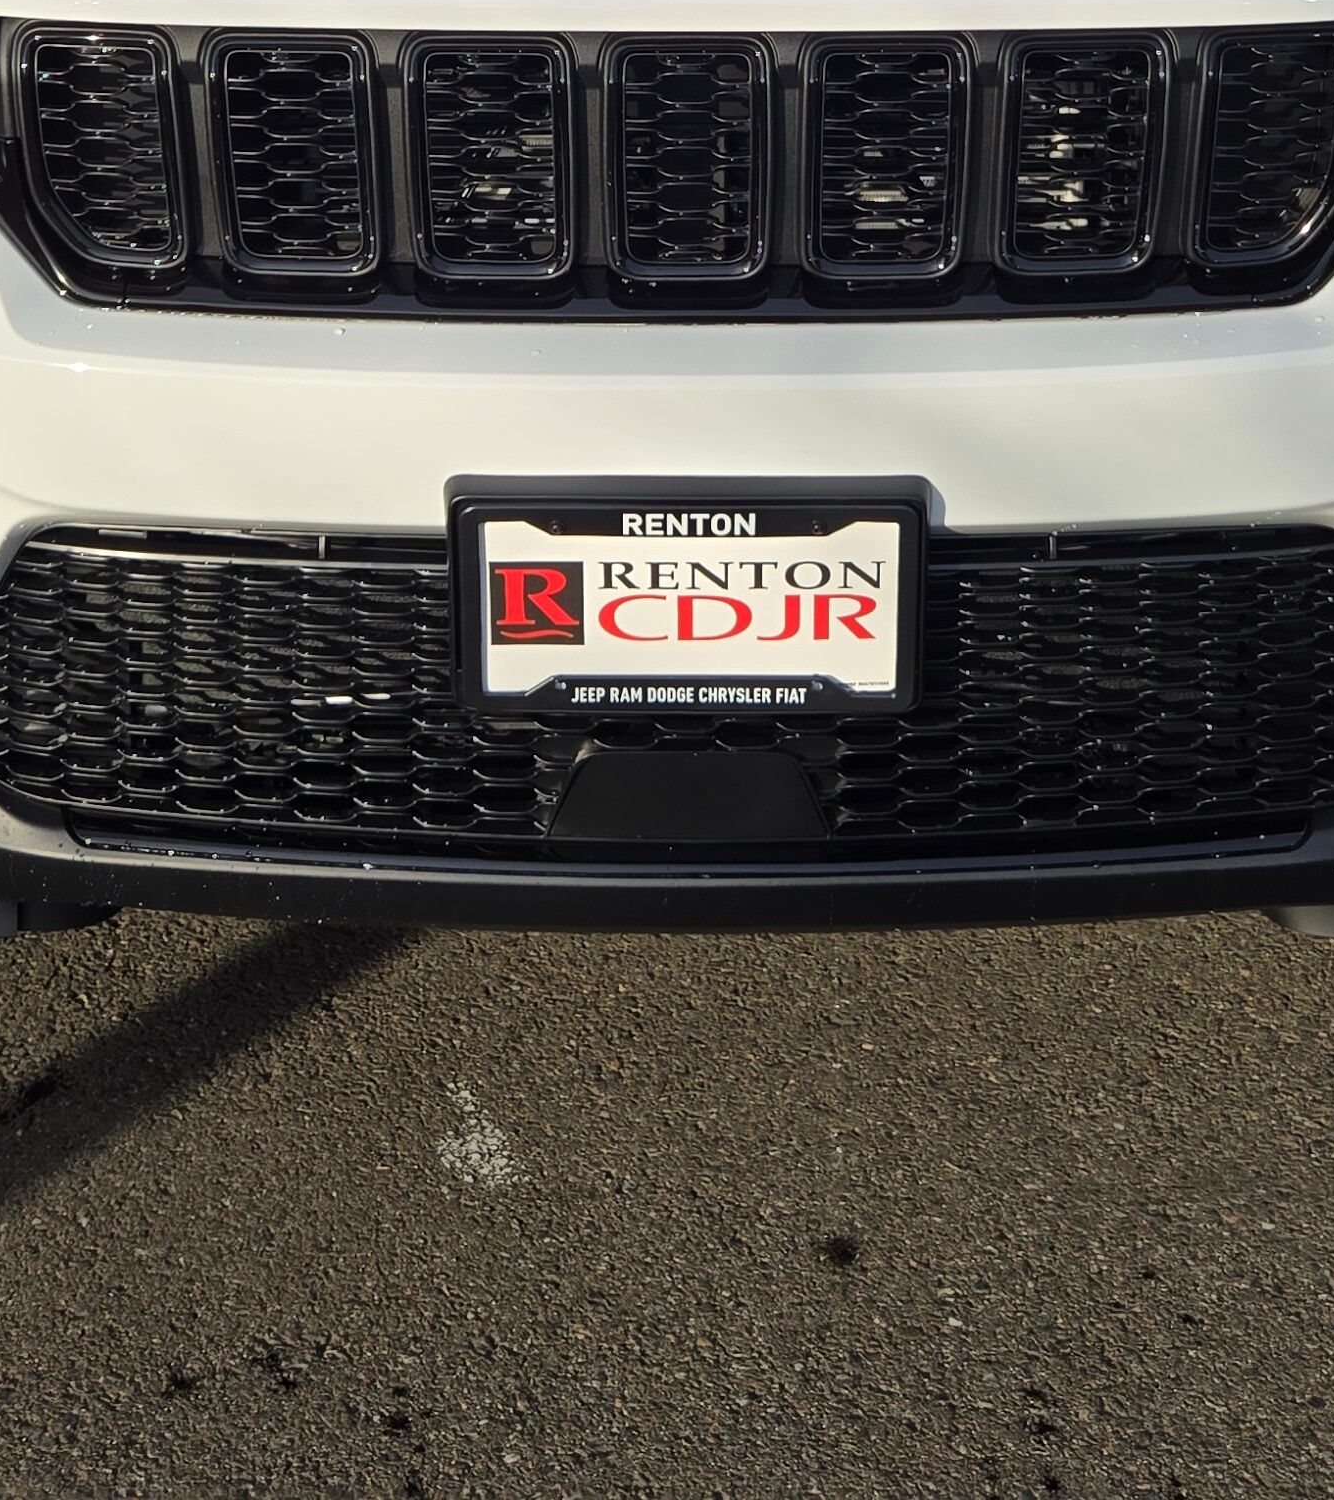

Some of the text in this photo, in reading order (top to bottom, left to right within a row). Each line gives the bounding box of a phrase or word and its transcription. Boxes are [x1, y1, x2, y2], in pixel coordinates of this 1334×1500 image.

[622, 513, 757, 537] RENTON
[597, 560, 886, 591] RENTON
[494, 567, 580, 626] R
[597, 593, 878, 641] CDJR
[571, 685, 807, 705] JEEP RAM DODGE CHRYSLER FIAT
